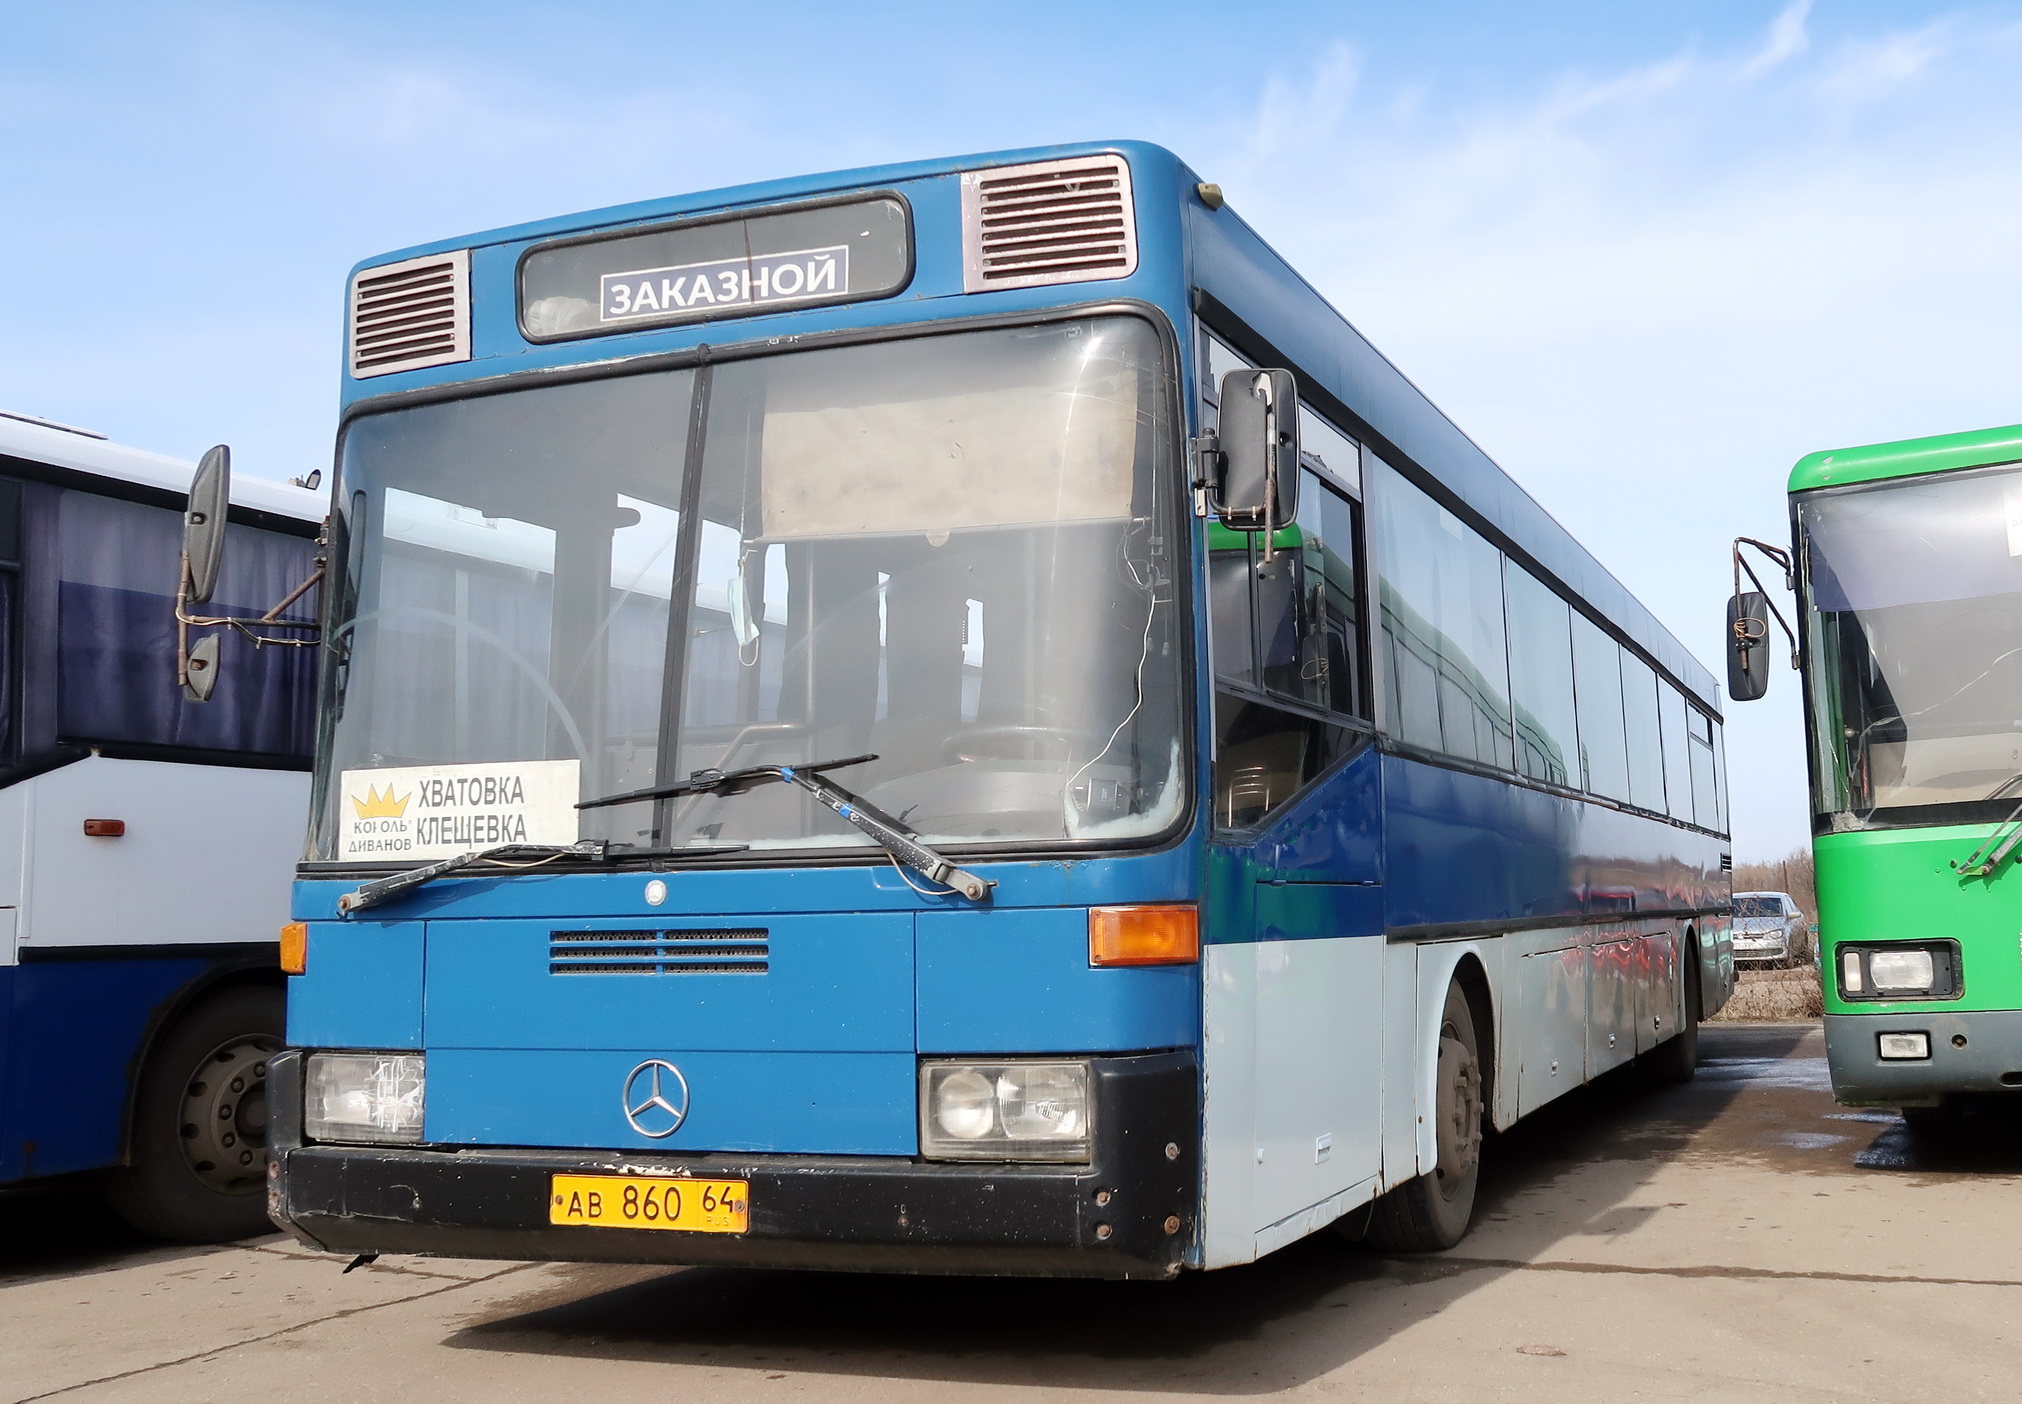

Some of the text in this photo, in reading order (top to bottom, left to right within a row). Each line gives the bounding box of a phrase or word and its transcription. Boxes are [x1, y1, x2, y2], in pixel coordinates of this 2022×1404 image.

[609, 254, 836, 315] ЗАКАЗНОЙ
[418, 776, 525, 808] ХВАТОВКА
[348, 838, 412, 853] ДИВАНОВ
[416, 814, 528, 849] КЛЕЩЕВКА
[622, 1185, 682, 1221] 860
[702, 1185, 734, 1213] 64
